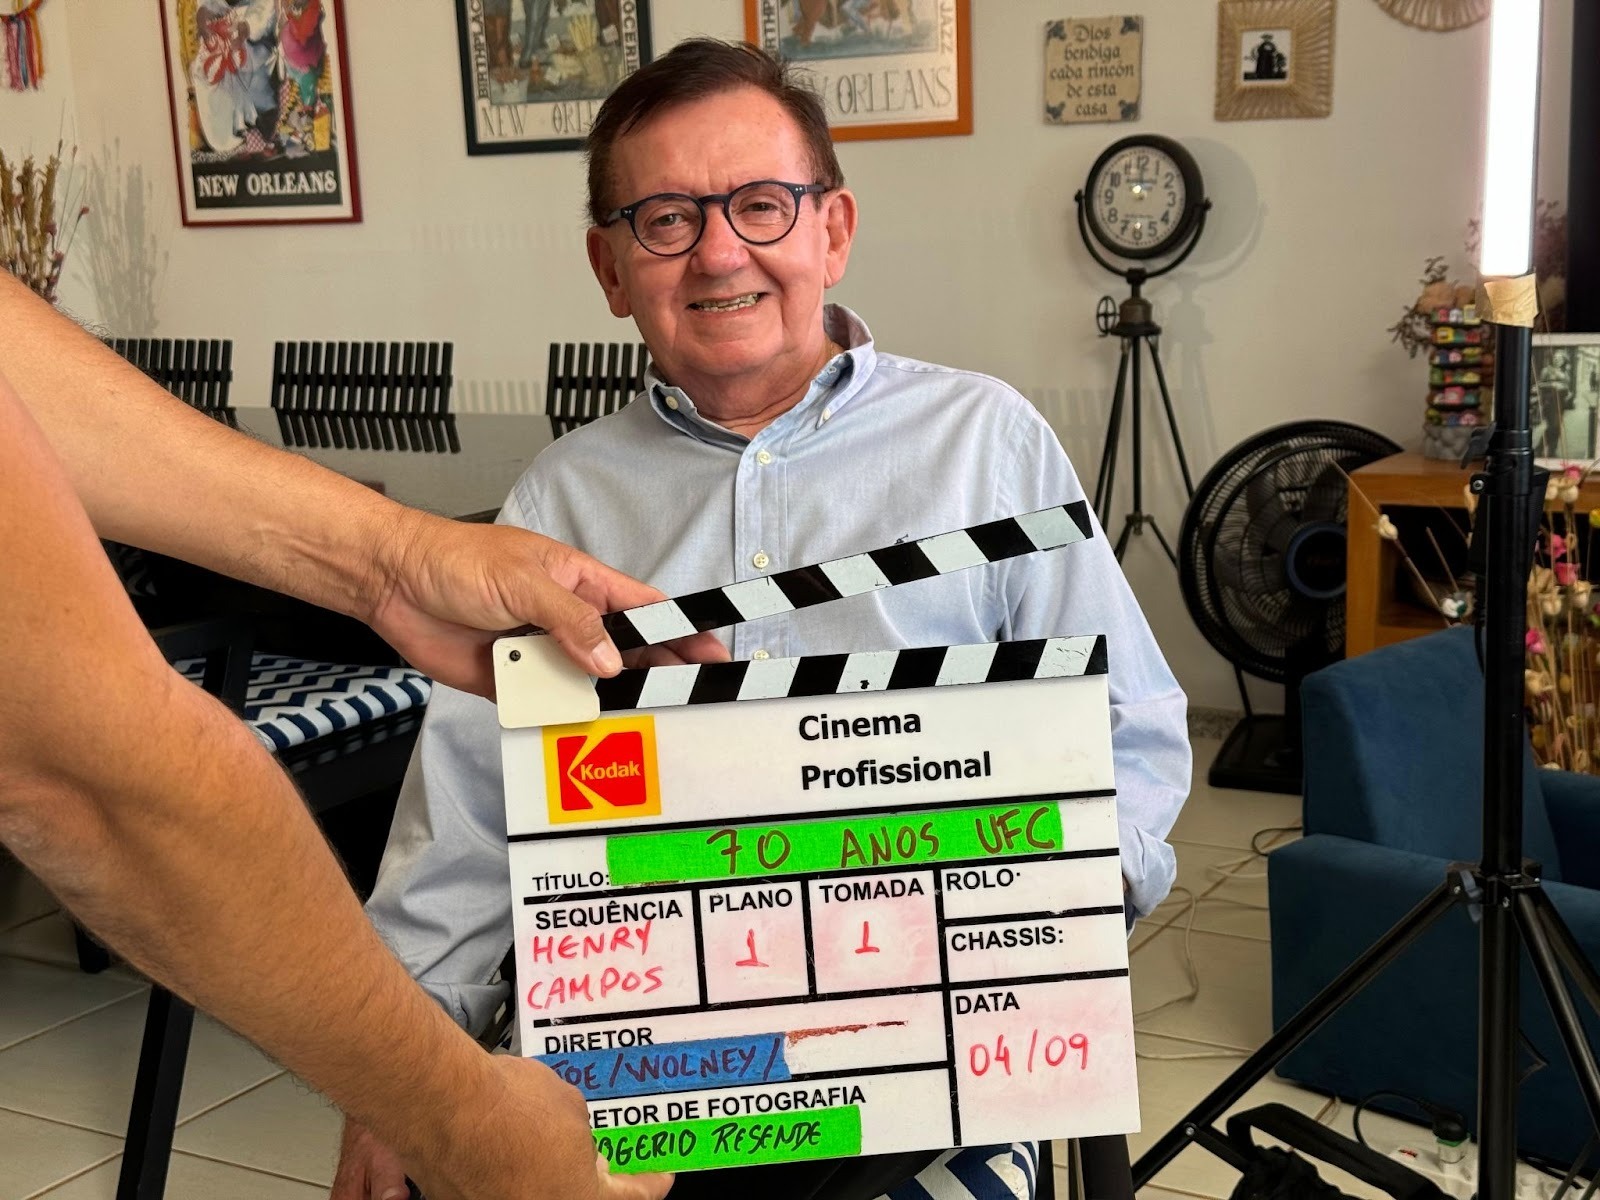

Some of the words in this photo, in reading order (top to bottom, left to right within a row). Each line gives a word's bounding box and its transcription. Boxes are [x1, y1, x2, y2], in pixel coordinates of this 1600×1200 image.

[1073, 24, 1111, 42] Dios
[1064, 43, 1120, 63] bendiga
[1050, 64, 1082, 79] cada
[838, 66, 951, 114] ORLEANS
[1067, 82, 1082, 98] de
[1088, 83, 1116, 96] esta
[482, 104, 528, 136] NEW
[1076, 102, 1108, 115] casa
[198, 174, 240, 197] NEW
[247, 170, 337, 196] ORLEANS
[1164, 172, 1174, 189] 2
[1104, 188, 1114, 205] 9
[1167, 191, 1176, 207] 3
[1107, 207, 1118, 223] 8
[1161, 210, 1169, 225] 4
[1148, 221, 1158, 237] 5
[799, 713, 921, 741] Cinema
[580, 760, 641, 780] Kodak
[801, 751, 991, 790] Profissional
[707, 829, 791, 874] 70
[841, 822, 939, 868] ANOS
[975, 807, 1055, 854] UFC
[532, 870, 610, 892] TÍTULO:
[819, 877, 924, 904] TOMADA
[709, 888, 793, 913] PLANO
[535, 899, 683, 930] SEQUÊNCIA
[532, 920, 653, 963] HENRY
[951, 926, 1064, 952] CHASSIS:
[527, 965, 664, 1009] CAMPOS
[955, 991, 1020, 1015] DATA
[544, 1027, 654, 1055] DIRETOR
[588, 1104, 660, 1129] ETOR
[667, 1101, 700, 1121] DE
[708, 1085, 866, 1118] FOTOGRAFIA
[593, 1128, 697, 1166] OGERIO
[711, 1121, 821, 1154] RESENDE
